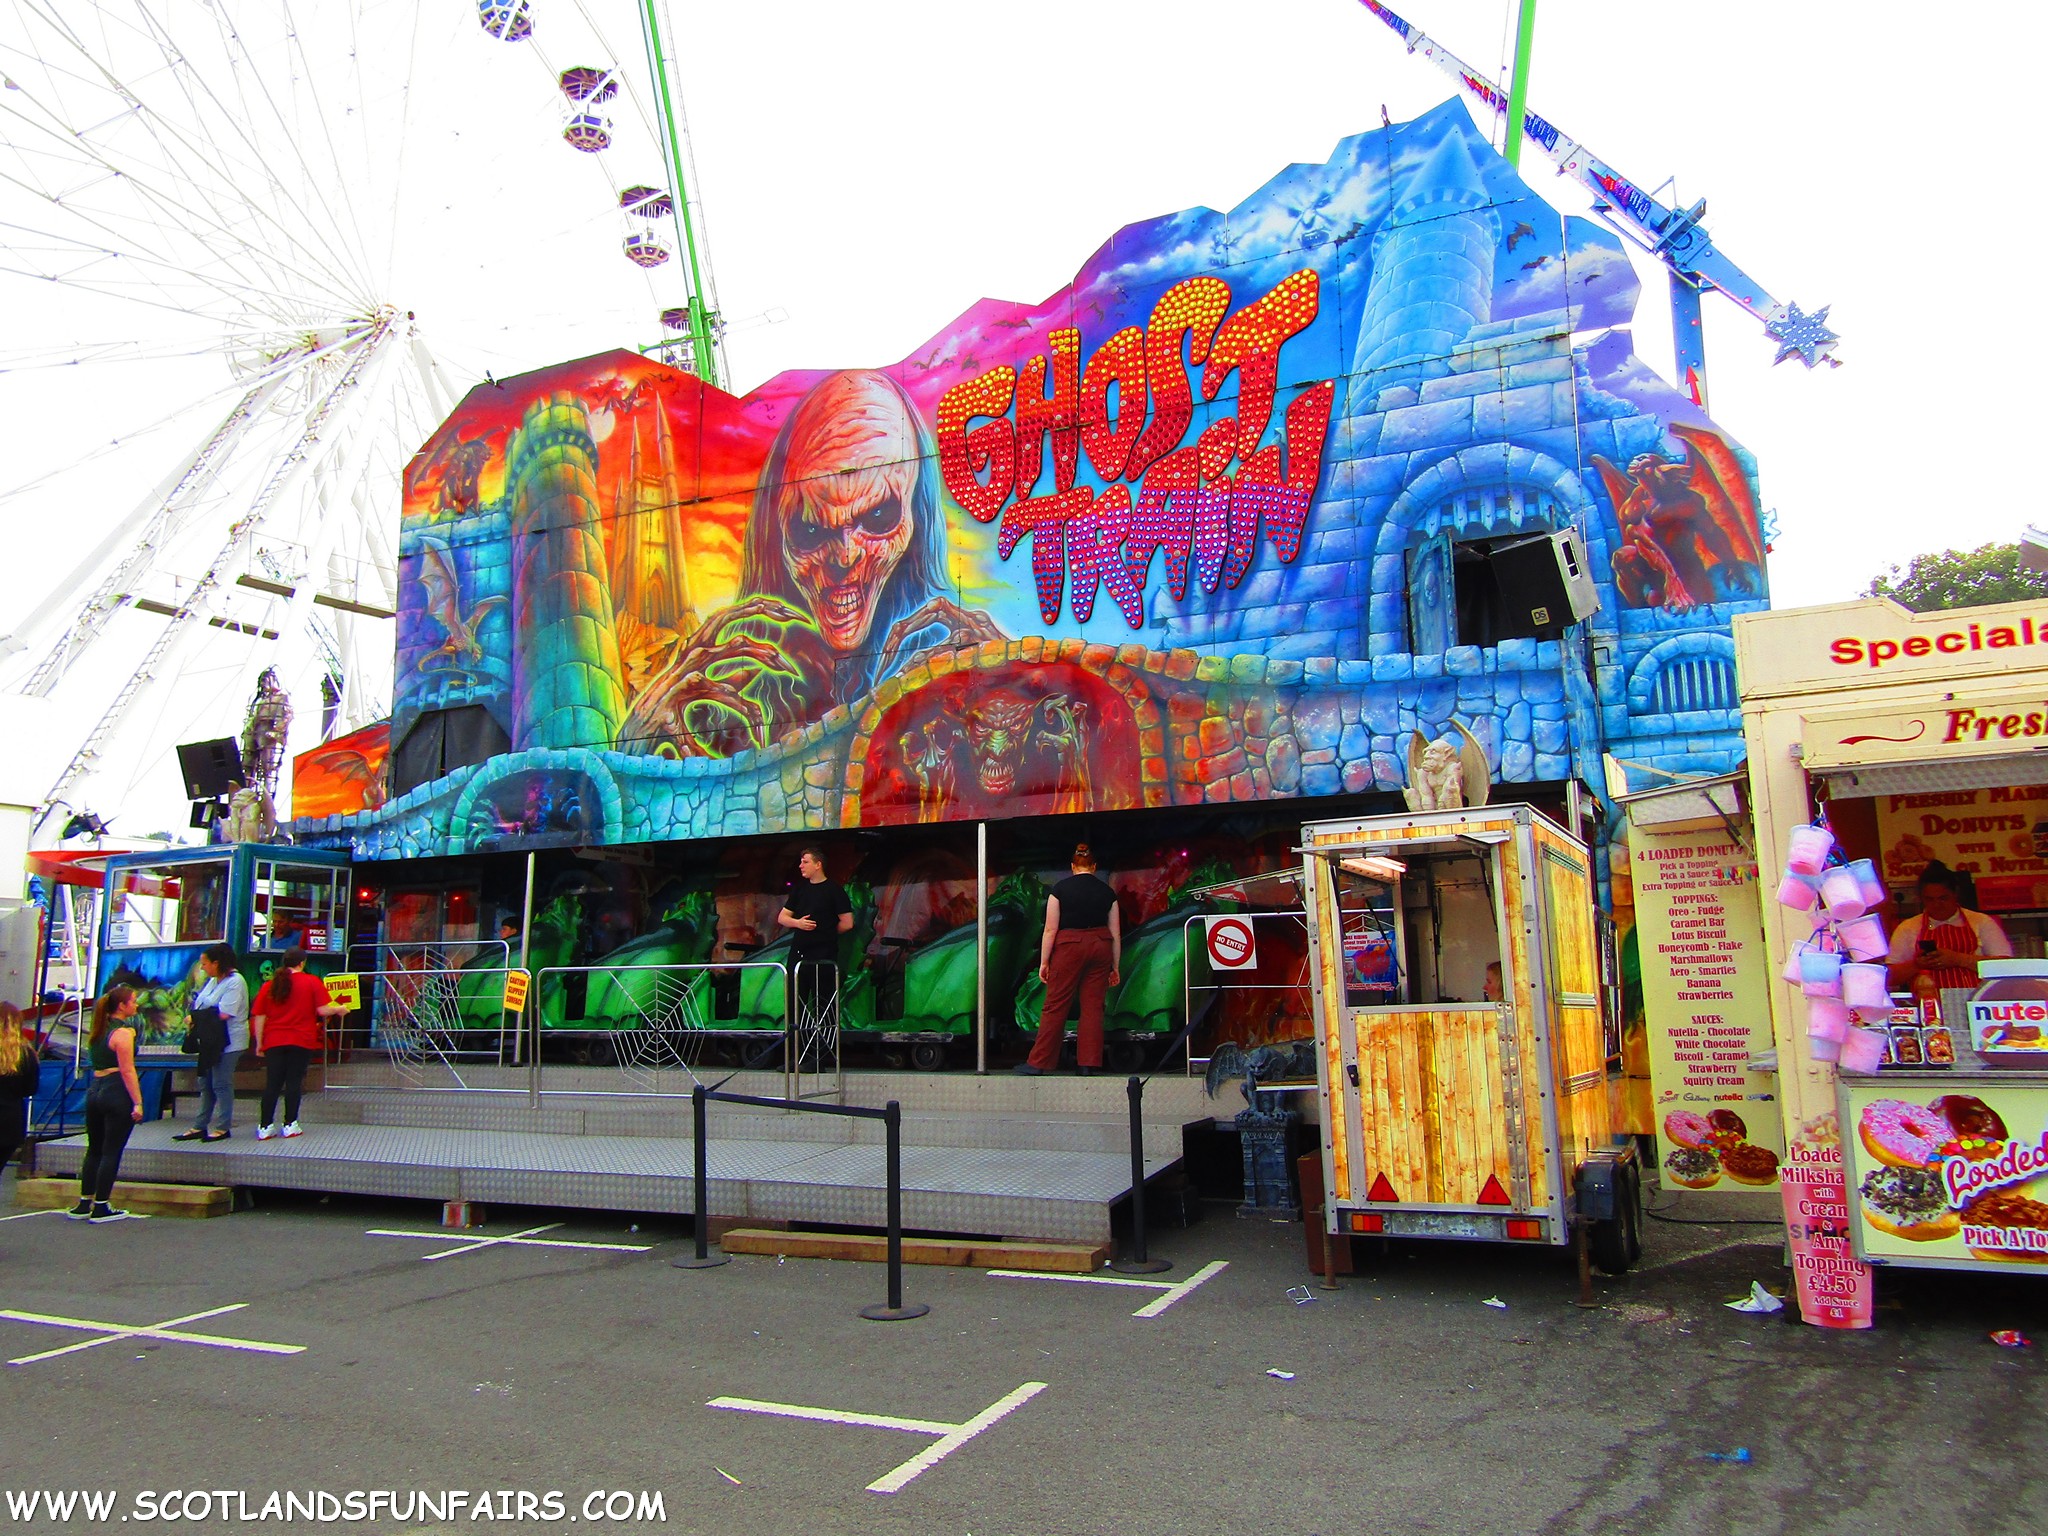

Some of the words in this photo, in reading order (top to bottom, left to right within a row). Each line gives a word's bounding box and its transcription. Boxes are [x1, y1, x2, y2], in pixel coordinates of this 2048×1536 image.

[936, 268, 1319, 522] GHOST
[997, 379, 1335, 630] TRAIN
[1637, 851, 1645, 861] 4
[1648, 846, 1693, 861] LOADED
[1660, 862, 1677, 870] Pick
[1687, 860, 1718, 869] Topping
[1660, 871, 1677, 880] Pick
[1687, 870, 1709, 879] Sauce
[1642, 883, 1662, 891] Extra
[1665, 880, 1696, 890] Topping
[1709, 879, 1731, 887] Sauce
[1672, 894, 1718, 904] TOPPINGS:
[1668, 907, 1689, 916] Oreo
[1697, 905, 1725, 915] Fudge
[1670, 918, 1706, 928] Caramel
[1709, 917, 1725, 927] Bar
[1671, 931, 1694, 940] Lotus
[1697, 929, 1726, 939] Biscuit
[1216, 935, 1225, 944] NO
[1226, 939, 1246, 951] ENTRY
[1658, 942, 1709, 953] Honeycomb
[1718, 941, 1743, 950] Flake
[1670, 954, 1733, 964] Marshmallows
[1669, 967, 1689, 976] Aero
[1698, 966, 1736, 976] Smarties
[326, 980, 357, 991] ENTRANCE
[510, 976, 526, 987] CAUTION
[1686, 979, 1721, 988] Banana
[1677, 990, 1733, 1000] Strawberries
[1691, 1015, 1724, 1024] SAUCES:
[1668, 1028, 1698, 1037] Nutella
[1707, 1027, 1750, 1036] Chocolate
[1675, 1040, 1700, 1049] White
[1702, 1039, 1746, 1048] Chocolate
[1712, 1051, 1749, 1060] Caramel
[1688, 1064, 1737, 1073] Strawberry
[1683, 1076, 1714, 1086] Squirty
[1717, 1076, 1745, 1085] Cream
[1714, 1093, 1743, 1101] nutella
[1947, 1131, 2048, 1204] Loaded
[1813, 1188, 1834, 1198] with
[1822, 1220, 1832, 1230] &
[1813, 1232, 1845, 1253] Any
[1963, 1227, 2003, 1246] Pick
[2008, 1229, 2020, 1247] A
[1796, 1253, 1866, 1276] Topping
[1808, 1274, 1857, 1294] £4.50
[1813, 1296, 1830, 1305] Add
[1831, 1297, 1859, 1307] Sauce
